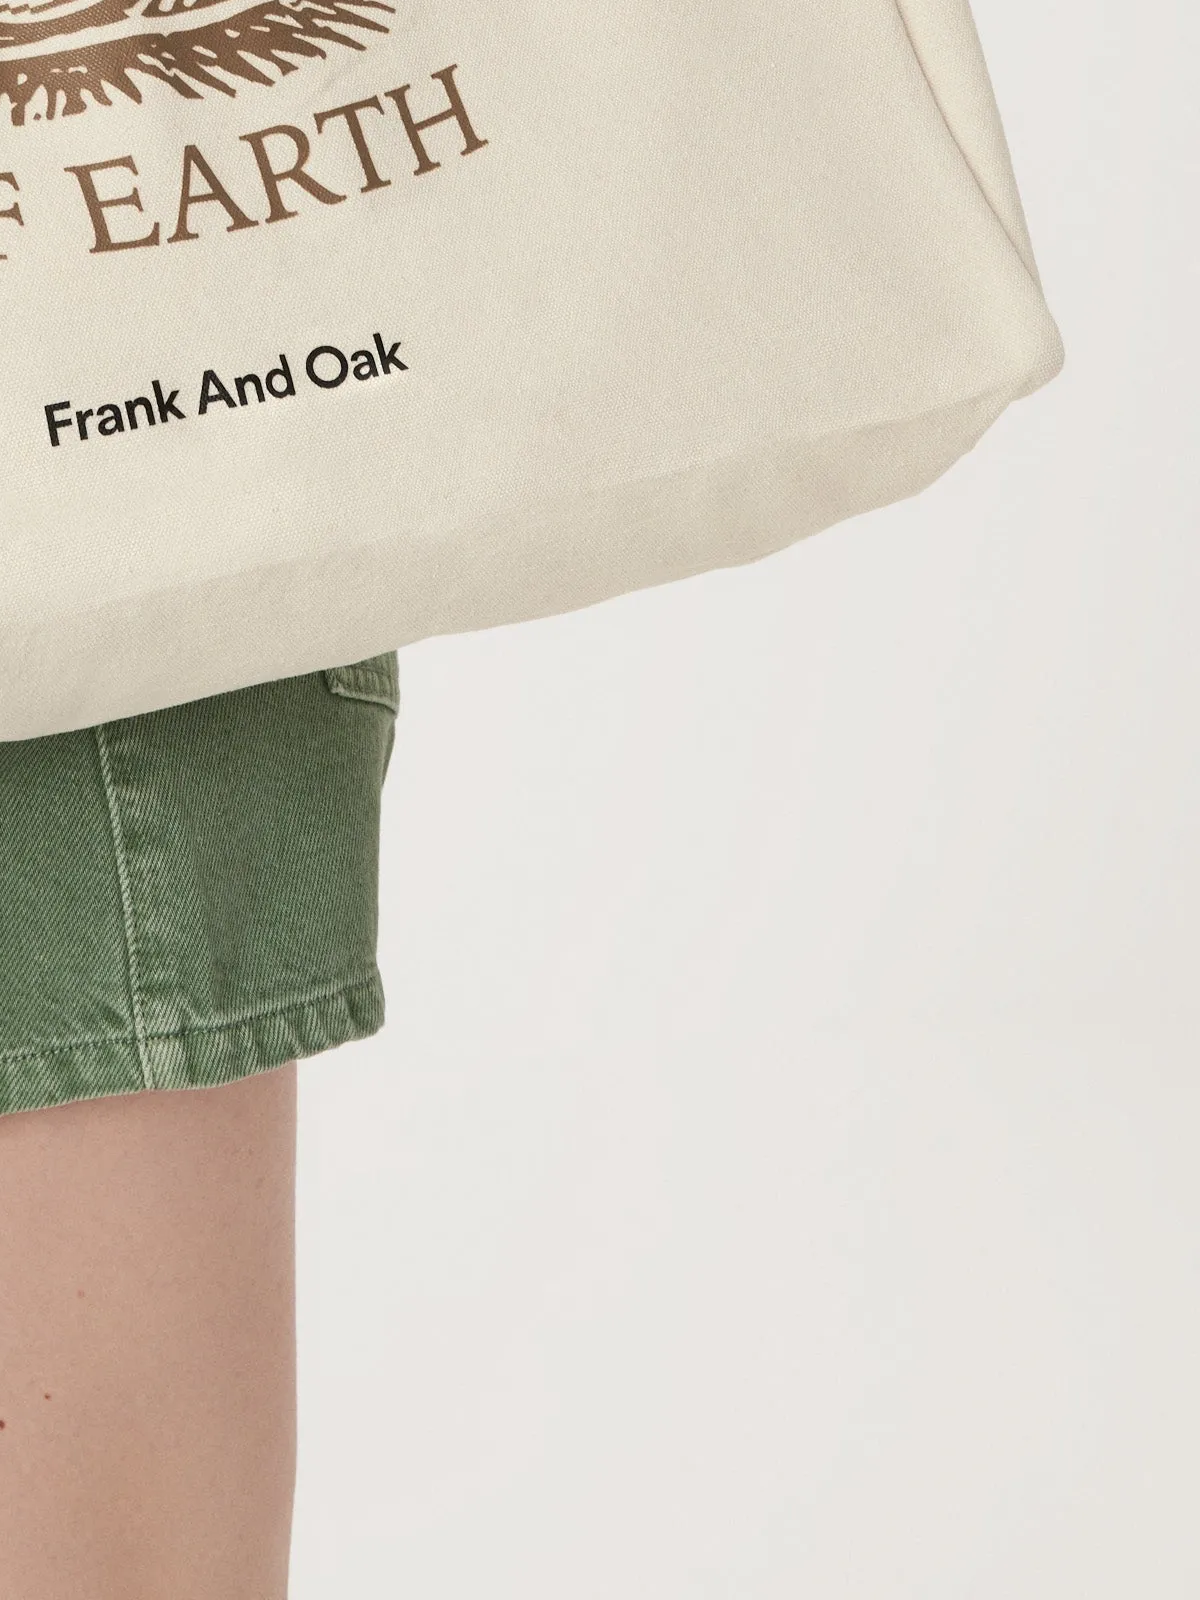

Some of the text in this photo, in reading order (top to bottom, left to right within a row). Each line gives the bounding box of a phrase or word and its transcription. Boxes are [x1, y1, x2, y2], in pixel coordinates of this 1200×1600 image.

[64, 63, 489, 254] EARTH
[43, 331, 409, 447] Frank And Oak
